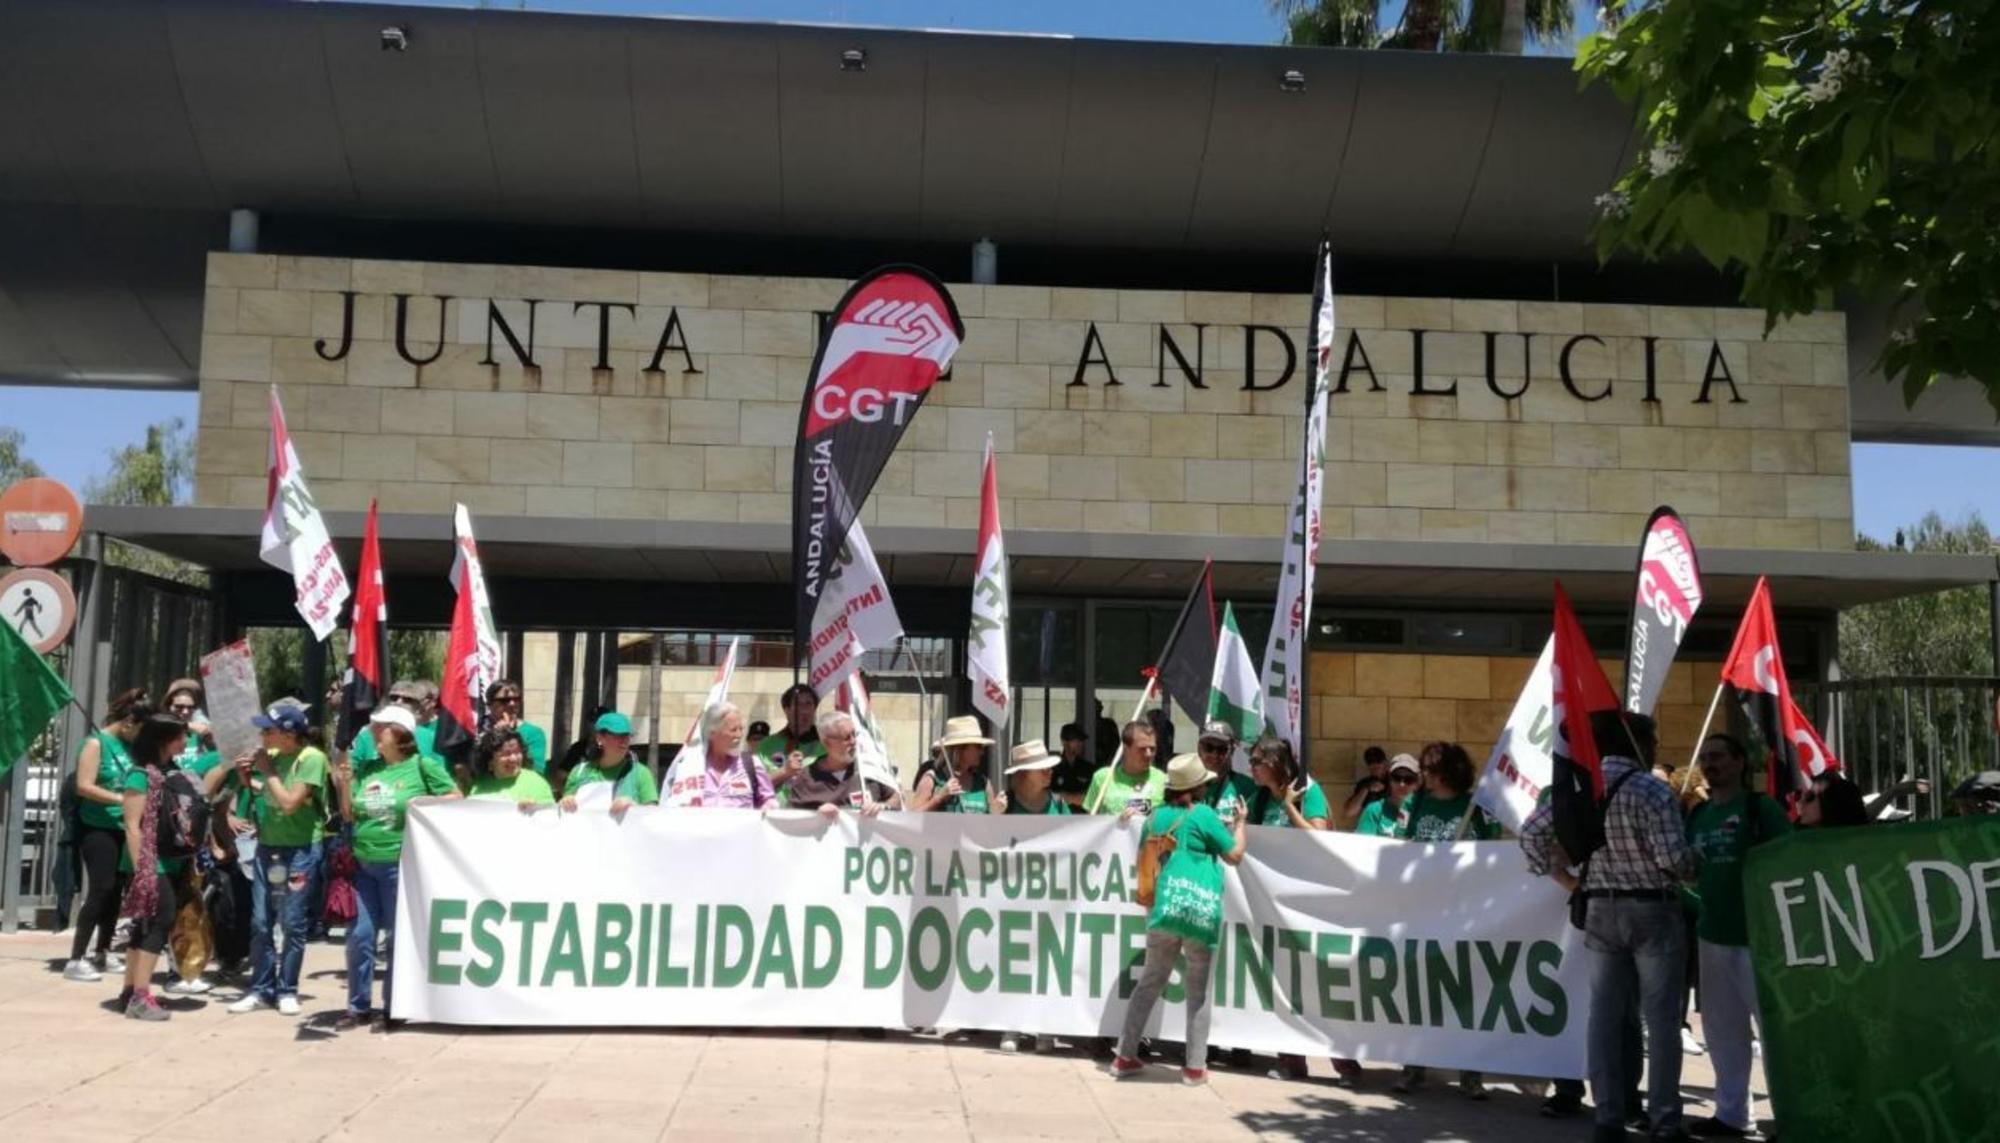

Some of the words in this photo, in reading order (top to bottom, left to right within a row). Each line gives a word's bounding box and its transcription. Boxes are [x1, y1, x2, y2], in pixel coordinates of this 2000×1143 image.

[313, 291, 703, 374] JUNTA
[1066, 321, 1749, 404] ANDALUCIA
[814, 384, 919, 428] CGT
[804, 438, 834, 599] ANDALUCÍA
[1639, 569, 1688, 646] CGT
[1627, 618, 1649, 713] DALUCÍA
[844, 846, 914, 895] POR
[924, 848, 968, 897] LA
[1771, 864, 1875, 967] EN
[427, 897, 843, 989] ESTABILIDAD
[1213, 921, 1569, 1037] INTERINXS
